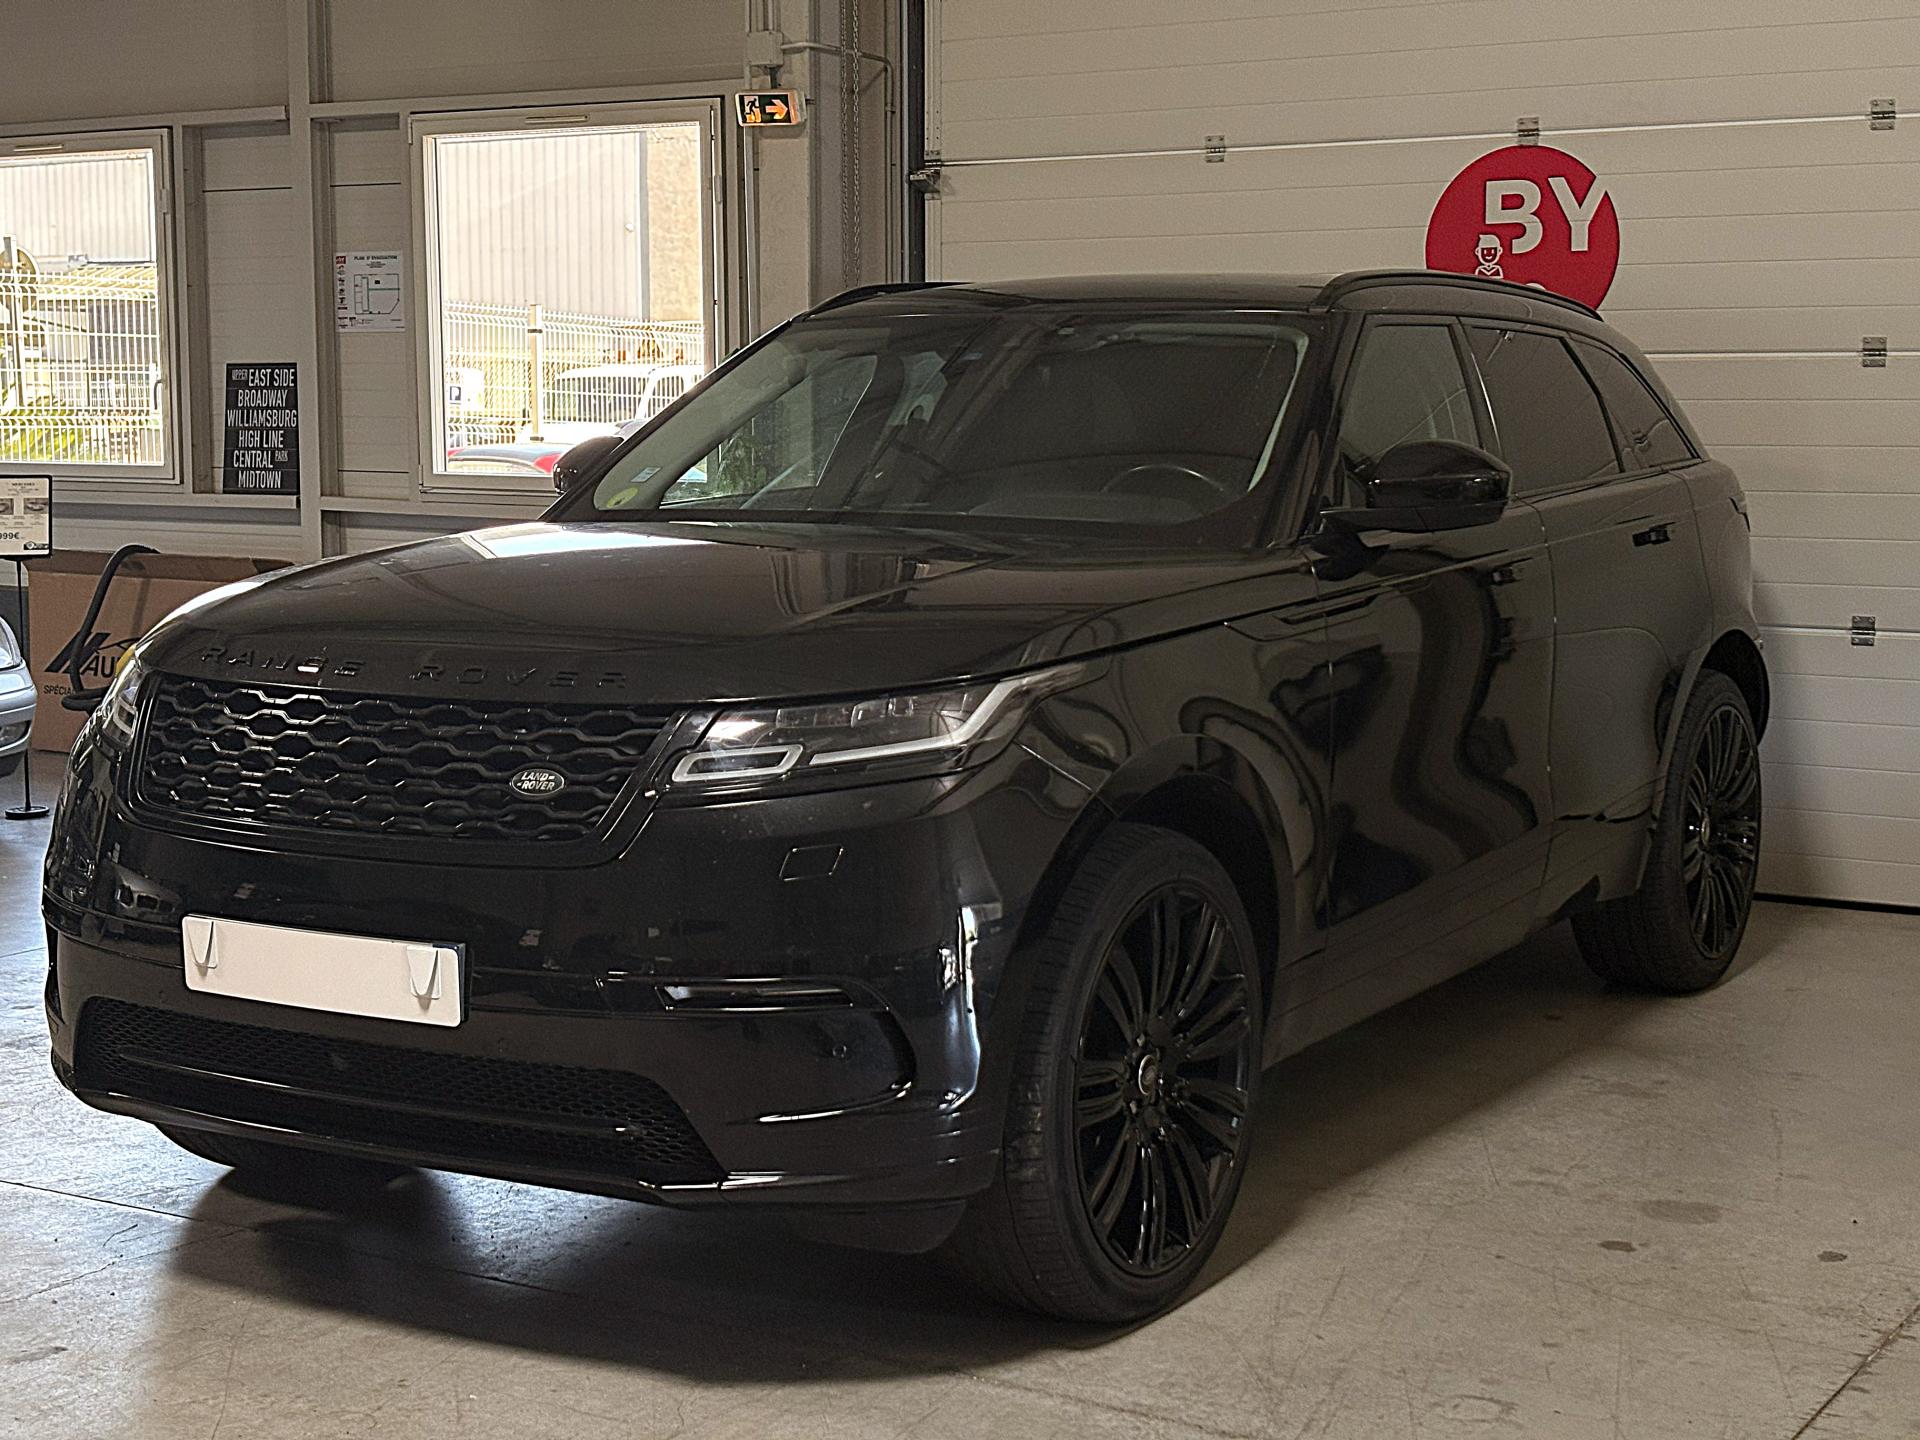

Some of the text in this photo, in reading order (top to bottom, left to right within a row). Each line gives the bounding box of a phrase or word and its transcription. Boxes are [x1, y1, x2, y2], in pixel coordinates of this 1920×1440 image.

[1485, 176, 1607, 254] BY
[249, 368, 271, 387] EAST
[273, 368, 295, 387] SIDE
[238, 389, 288, 407] BROADWAY
[227, 409, 297, 428] WILLIAMSBURG
[238, 430, 284, 448] HIGH LINE
[233, 450, 288, 468] CENTRAL PARK
[238, 470, 281, 488] MIDTOWN
[200, 647, 628, 690] RANGE ROVER
